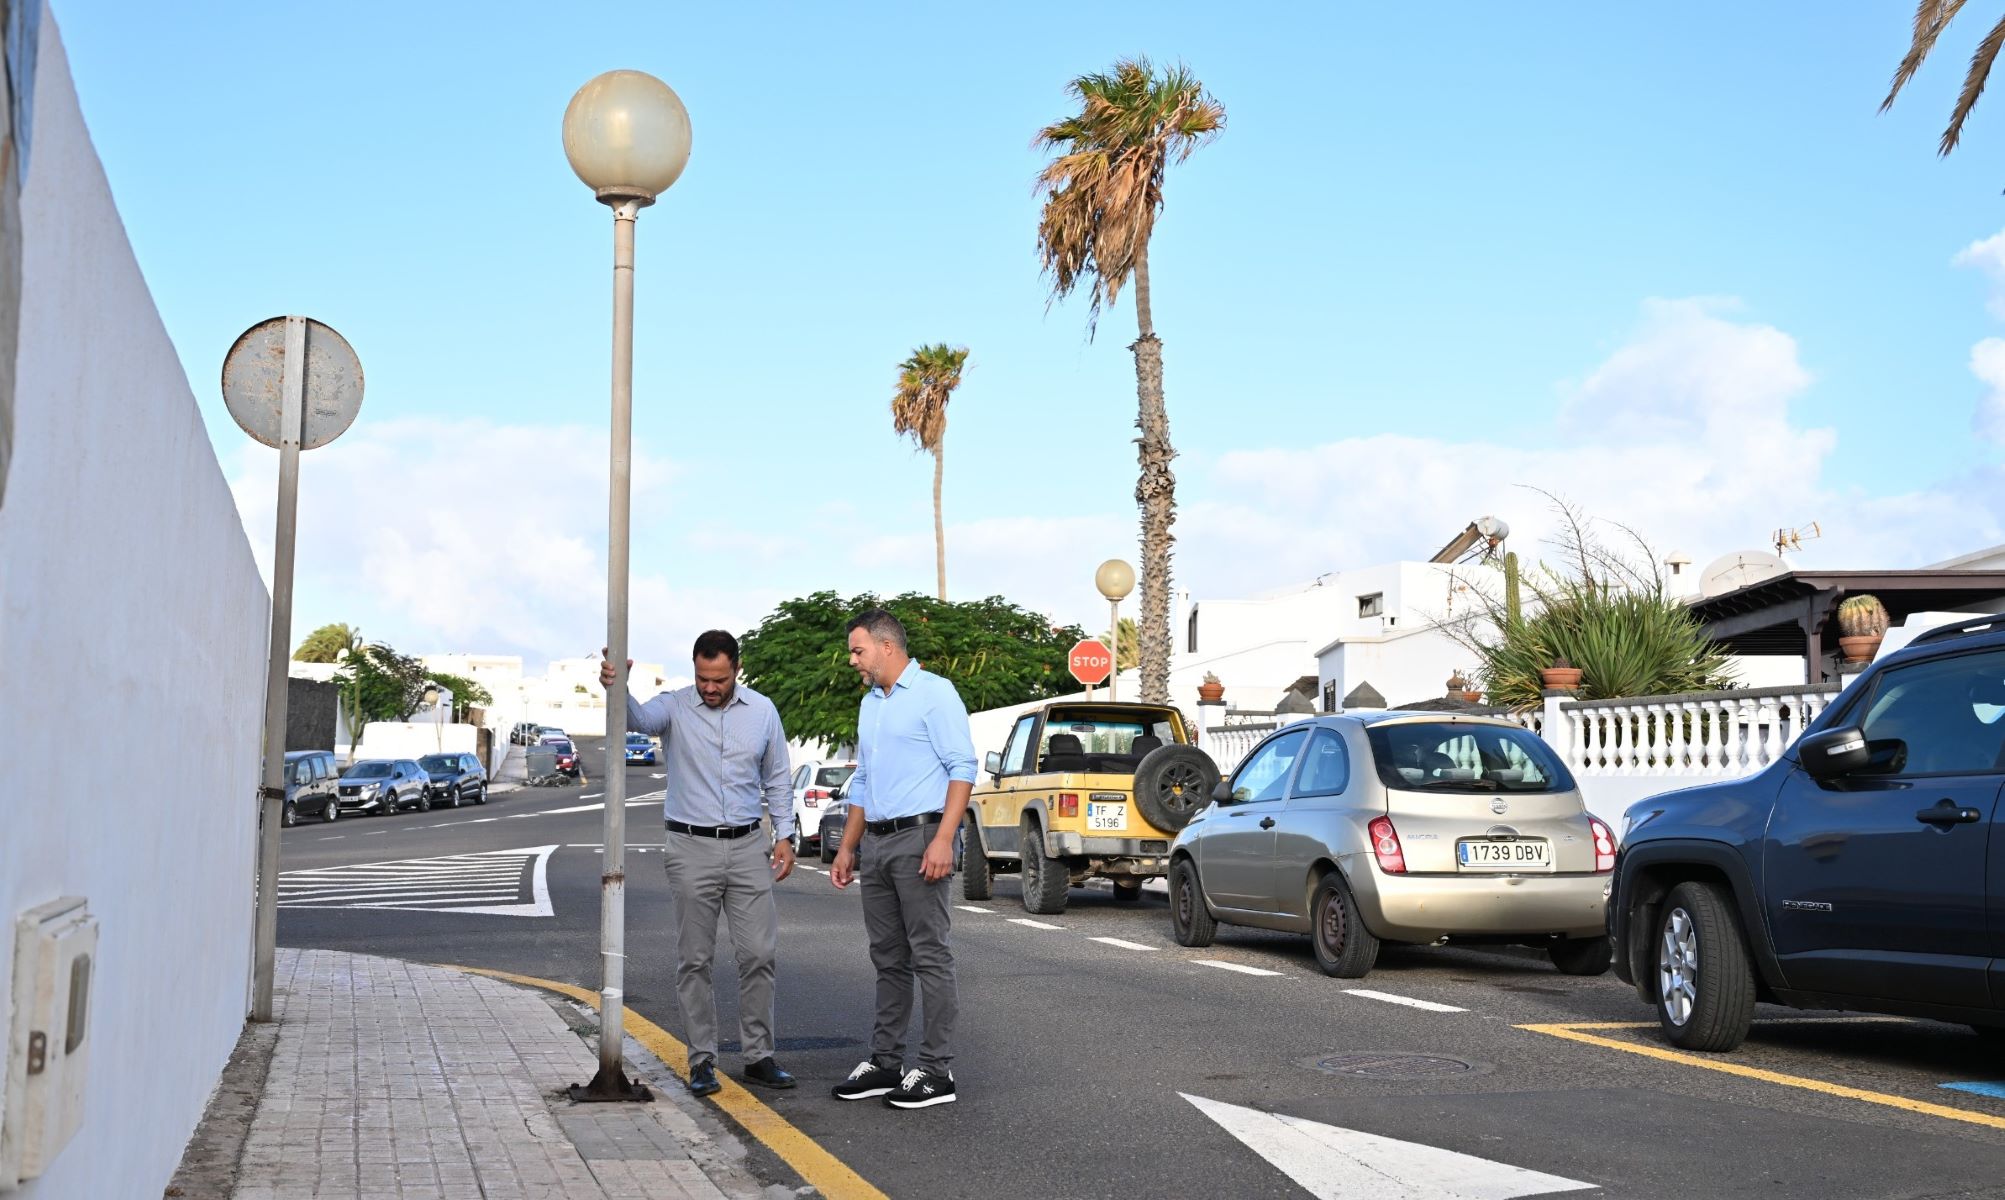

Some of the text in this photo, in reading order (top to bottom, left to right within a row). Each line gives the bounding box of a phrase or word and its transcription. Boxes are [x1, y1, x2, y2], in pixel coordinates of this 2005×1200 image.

[1073, 656, 1108, 668] STOP
[1095, 805, 1124, 816] TF Z
[1095, 817, 1119, 828] 5196
[1472, 845, 1543, 861] 1739 DBV
[1782, 900, 1832, 911] RENEGADE
